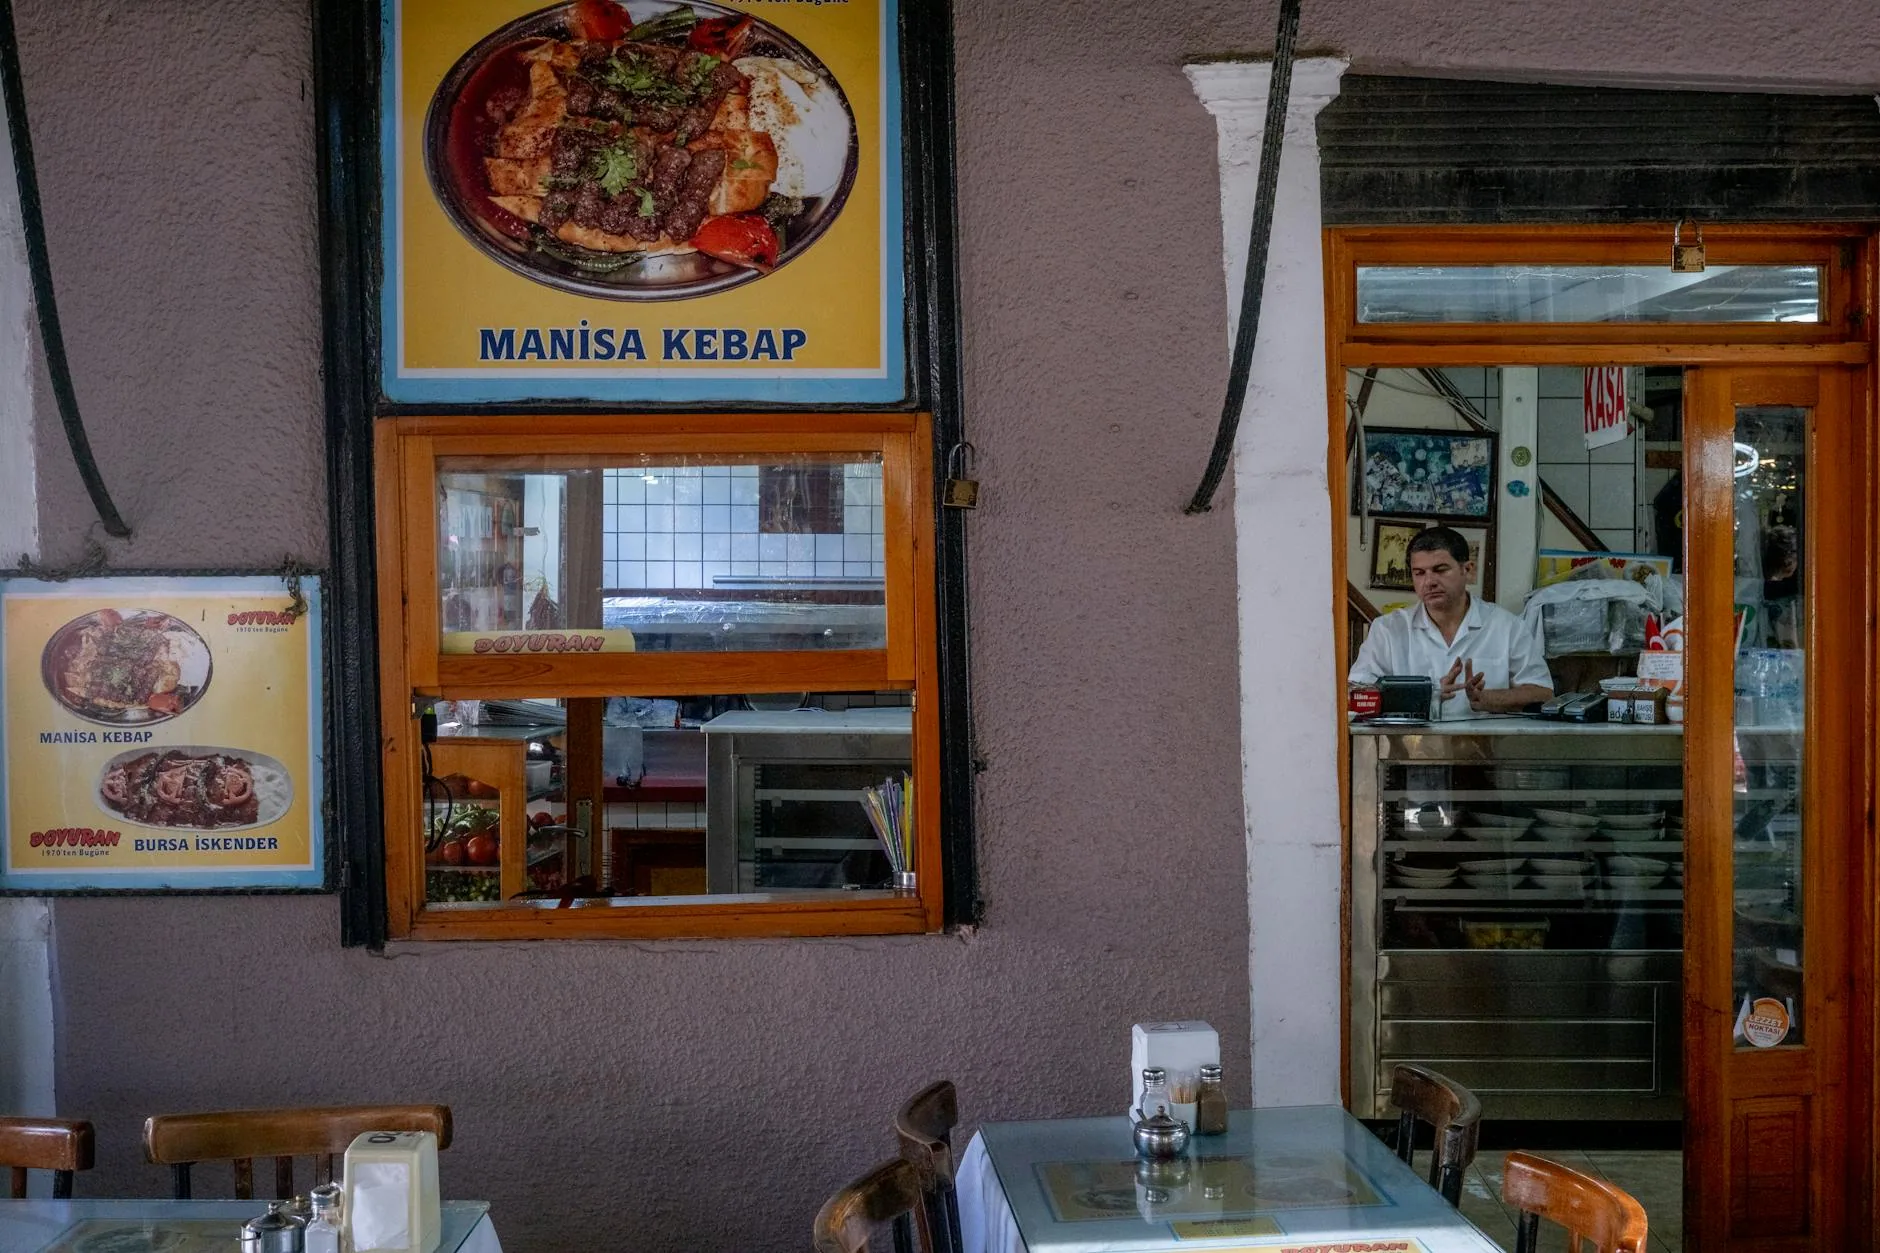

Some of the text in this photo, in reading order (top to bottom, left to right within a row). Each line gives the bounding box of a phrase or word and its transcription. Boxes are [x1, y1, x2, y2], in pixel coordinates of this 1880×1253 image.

[479, 319, 807, 361] MANİSA KEBAP
[1584, 367, 1626, 433] KASA
[227, 611, 297, 626] DOYURAN
[473, 634, 605, 653] DOYURAN
[40, 729, 153, 743] MANİSA KEBAP
[29, 828, 121, 848] DOYURAN
[134, 834, 279, 851] BURSA İSKENDER
[1749, 1015, 1783, 1028] LEZZET
